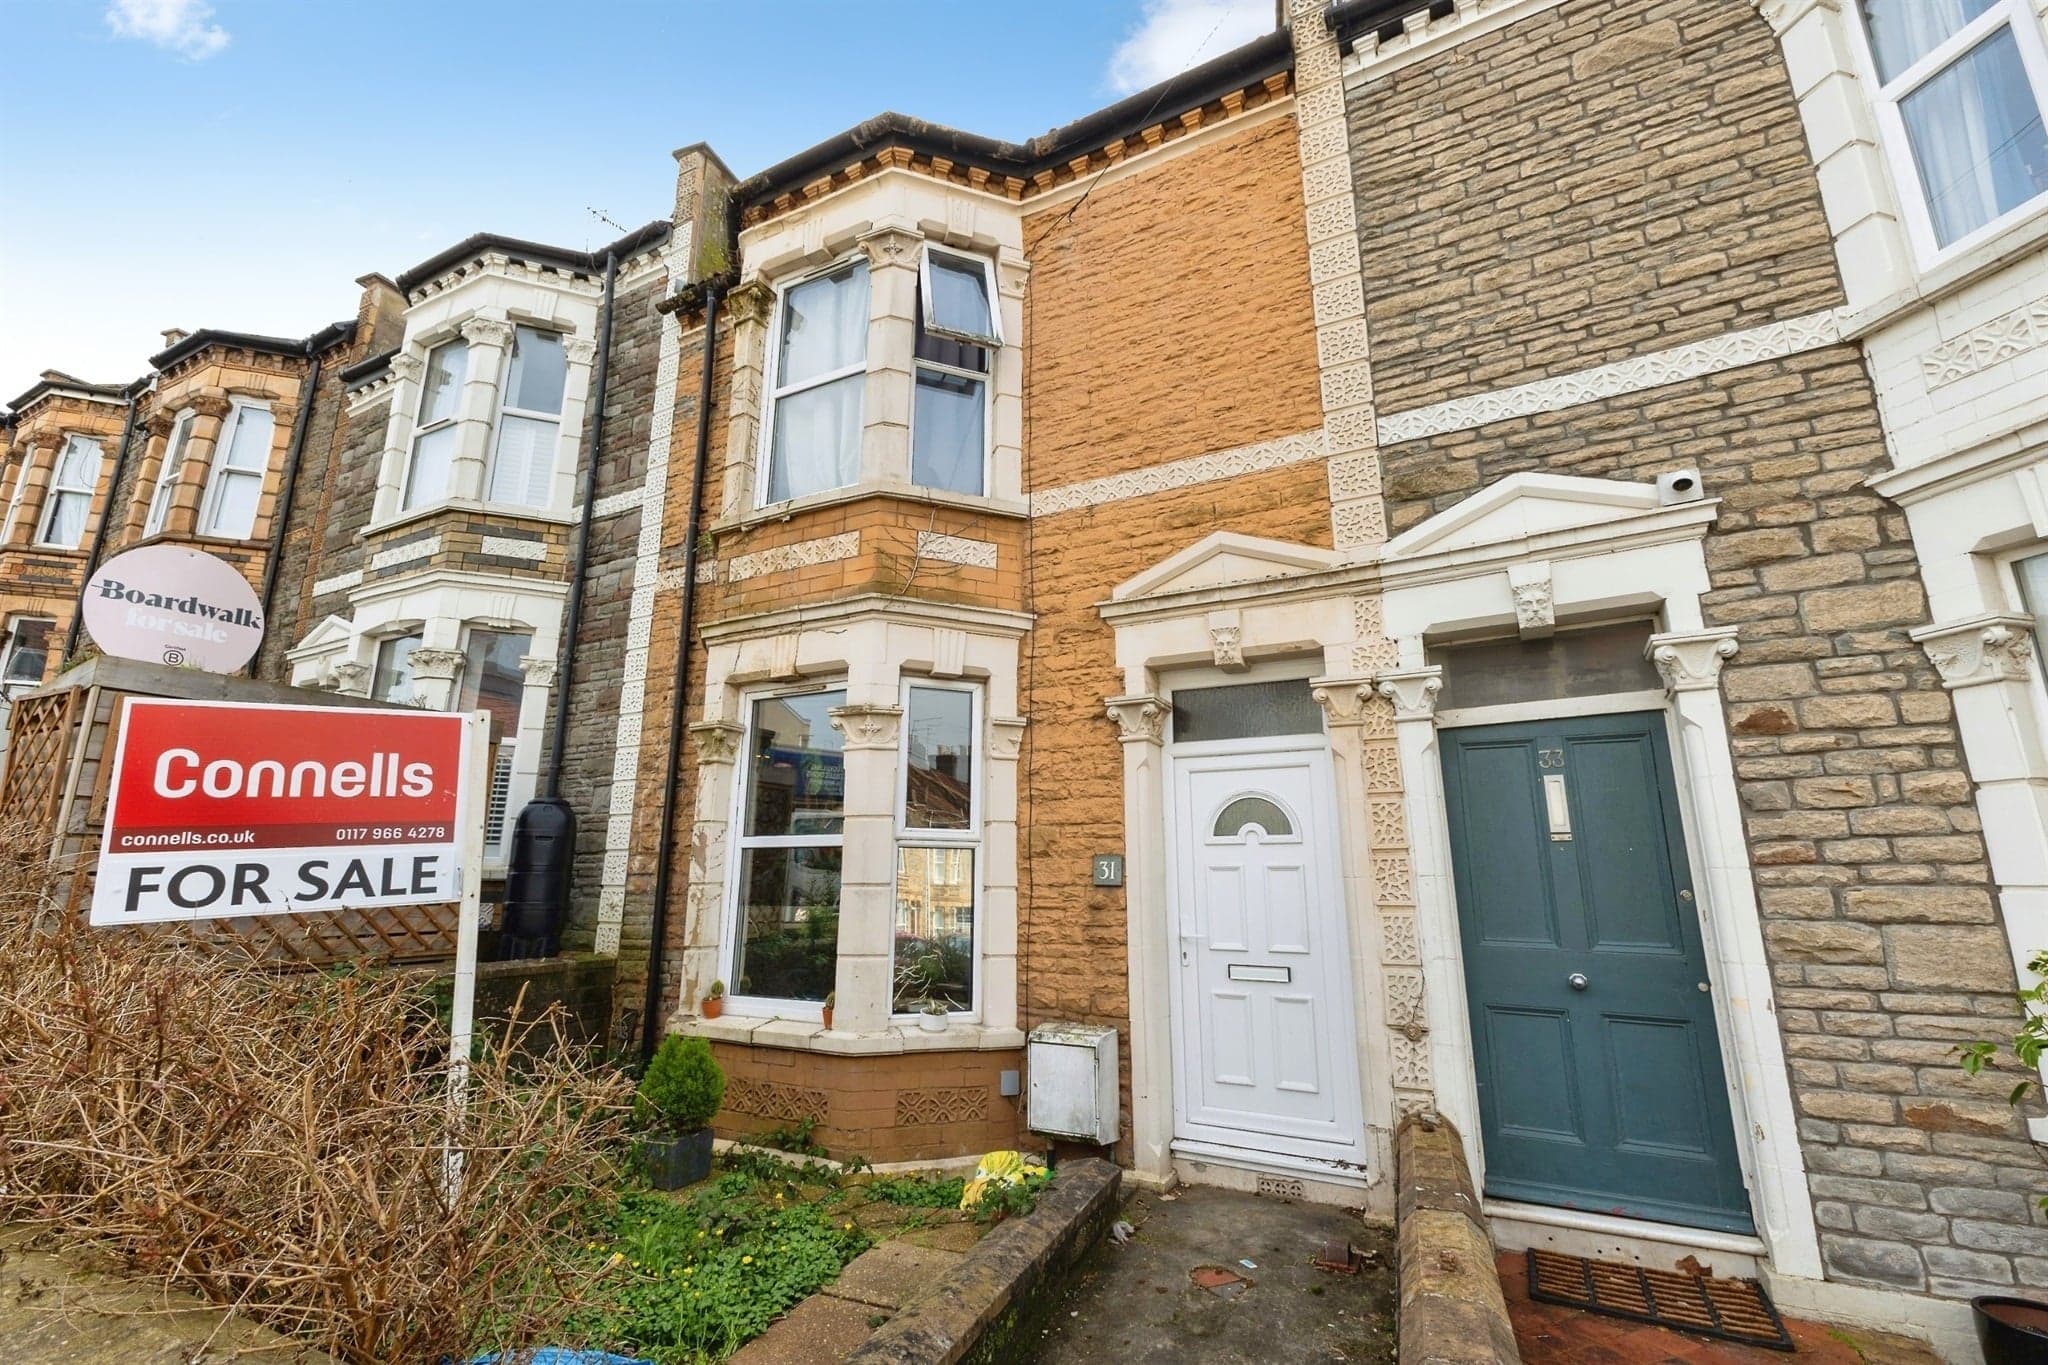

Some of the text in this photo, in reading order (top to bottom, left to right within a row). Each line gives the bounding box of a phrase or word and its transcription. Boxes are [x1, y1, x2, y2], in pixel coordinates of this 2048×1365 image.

[91, 579, 261, 629] Boardwalk
[125, 607, 228, 644] for sale
[1538, 749, 1564, 768] 33
[153, 748, 434, 799] Connells
[121, 830, 255, 847] connells.co.uk
[336, 826, 445, 840] 0117 966 4278
[125, 856, 439, 912] FOR SALE
[1099, 861, 1115, 879] 31
